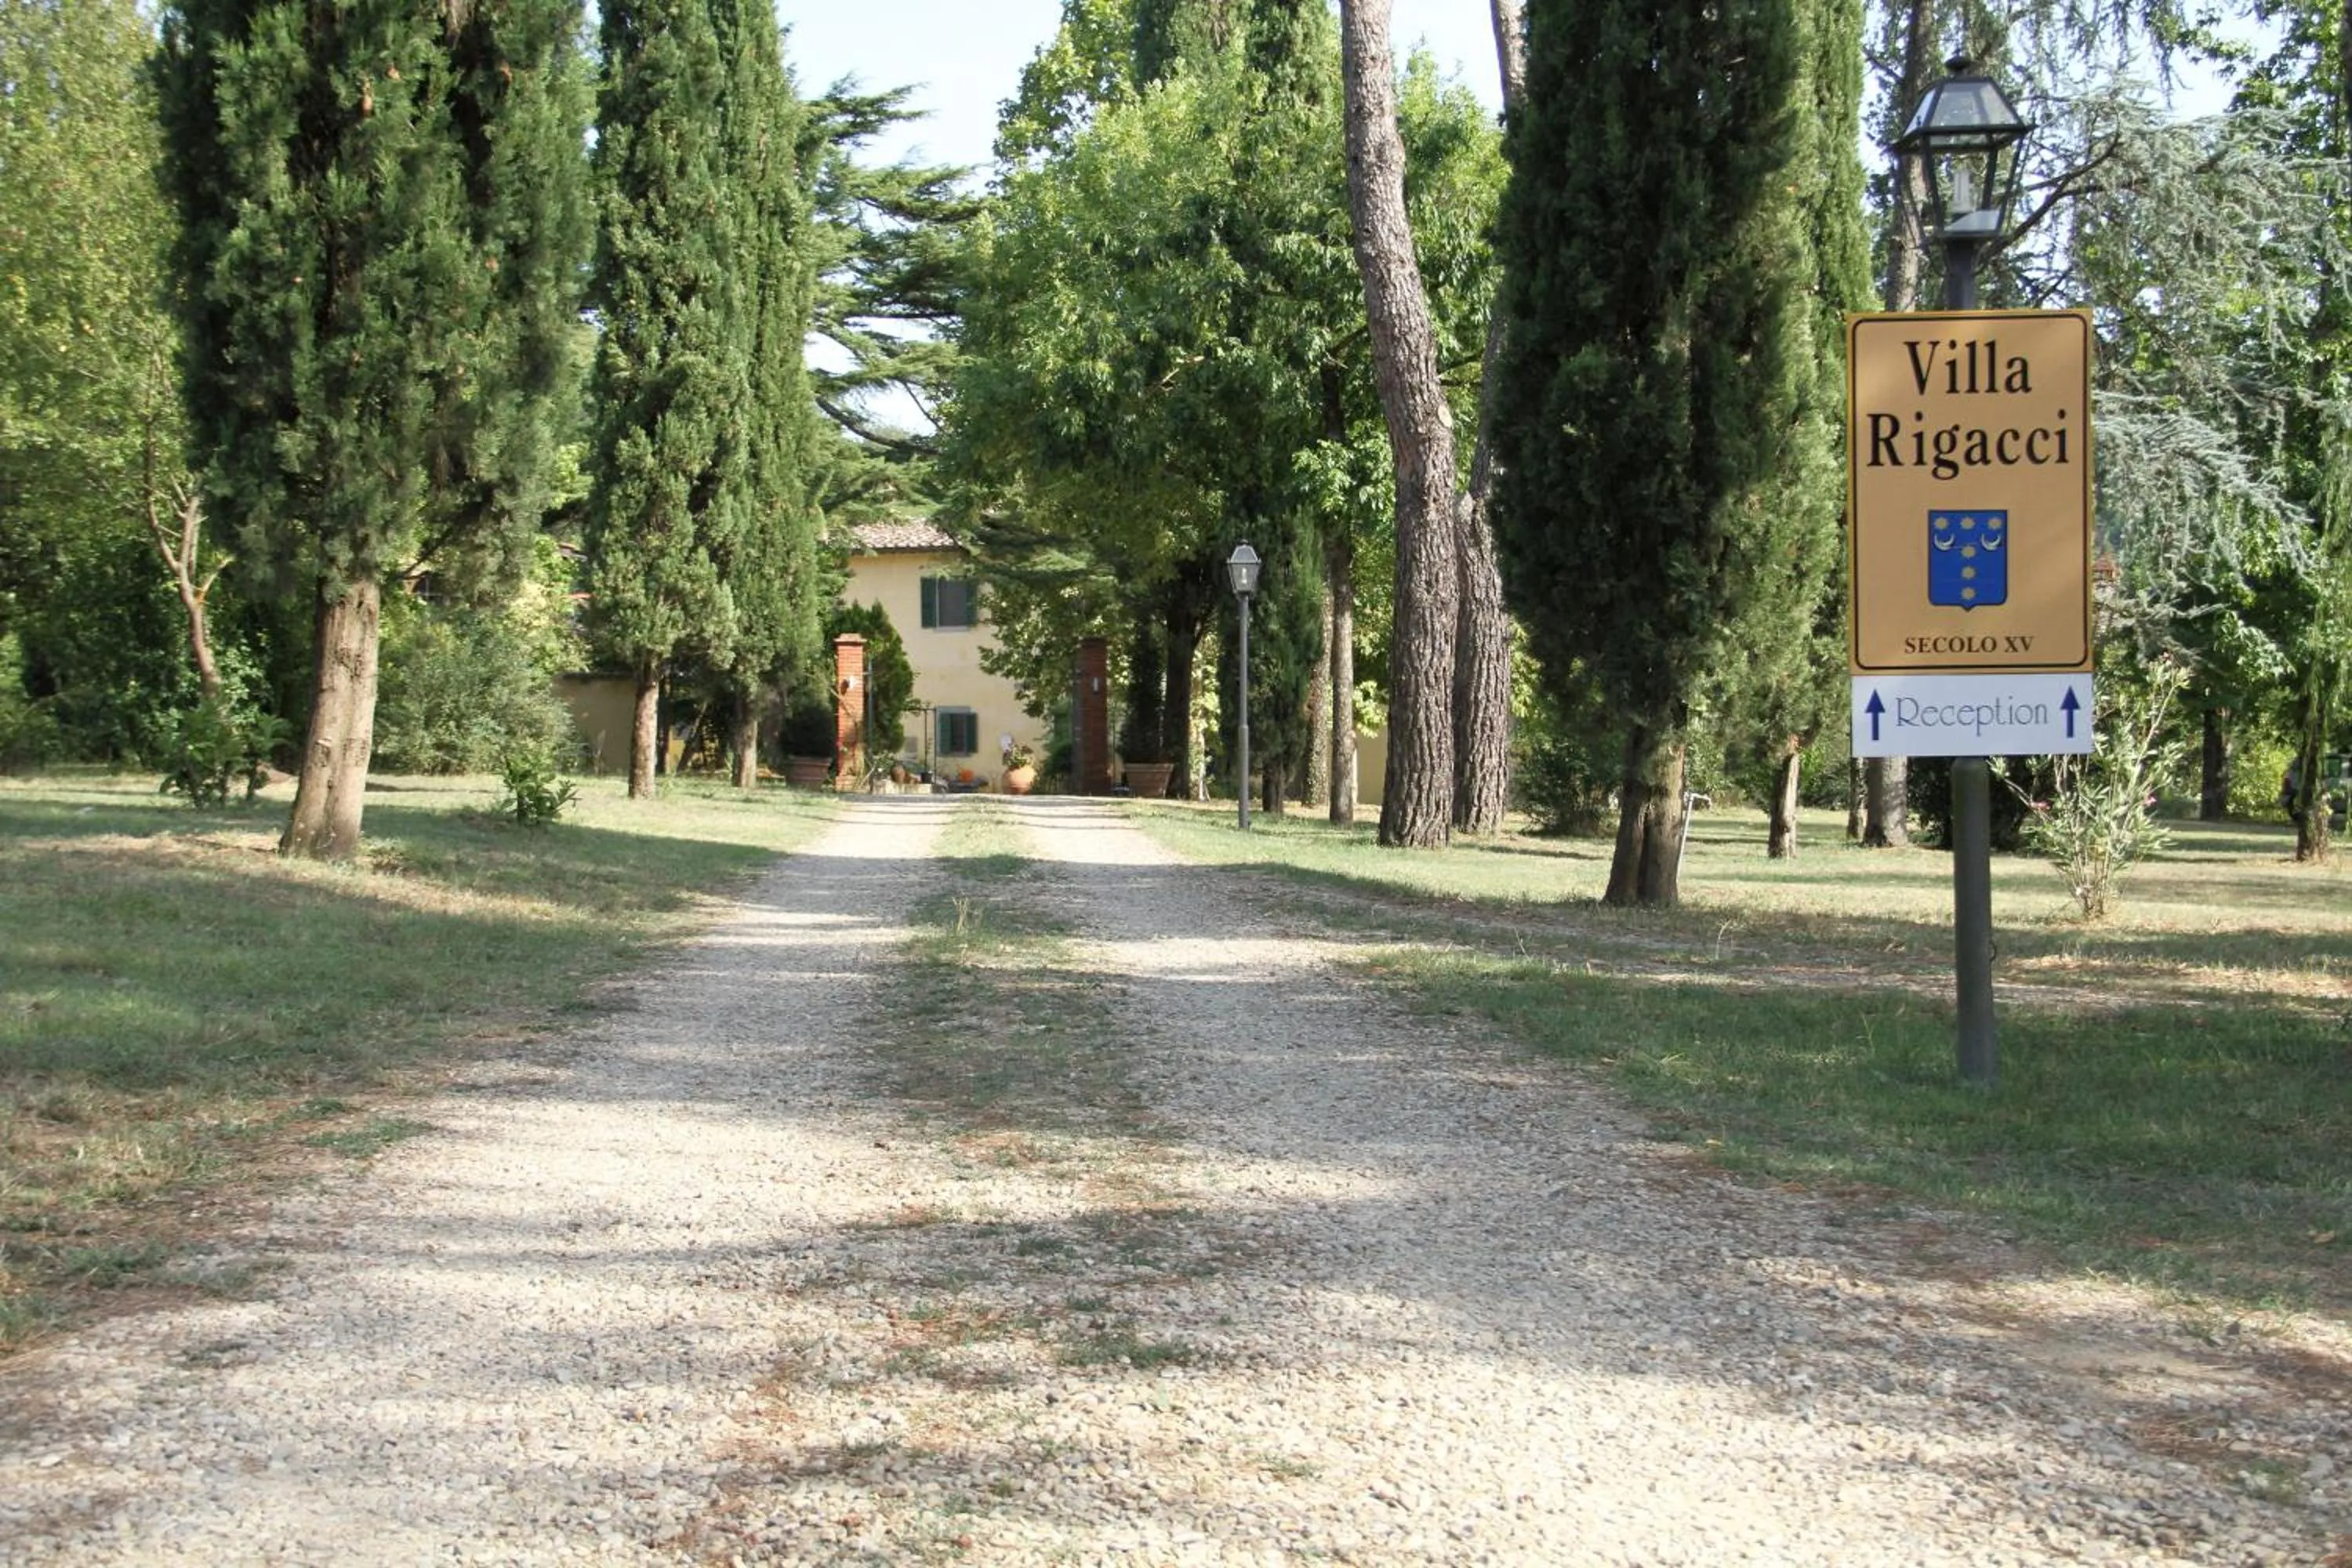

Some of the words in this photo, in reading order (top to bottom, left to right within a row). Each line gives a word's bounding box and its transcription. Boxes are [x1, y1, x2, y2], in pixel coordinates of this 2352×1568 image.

[1904, 339, 2033, 396] Villa
[1866, 408, 2070, 481] Rigacci
[1904, 636, 1998, 654] SECOLO
[2004, 635, 2034, 653] XV
[1895, 695, 2049, 737] Reception
